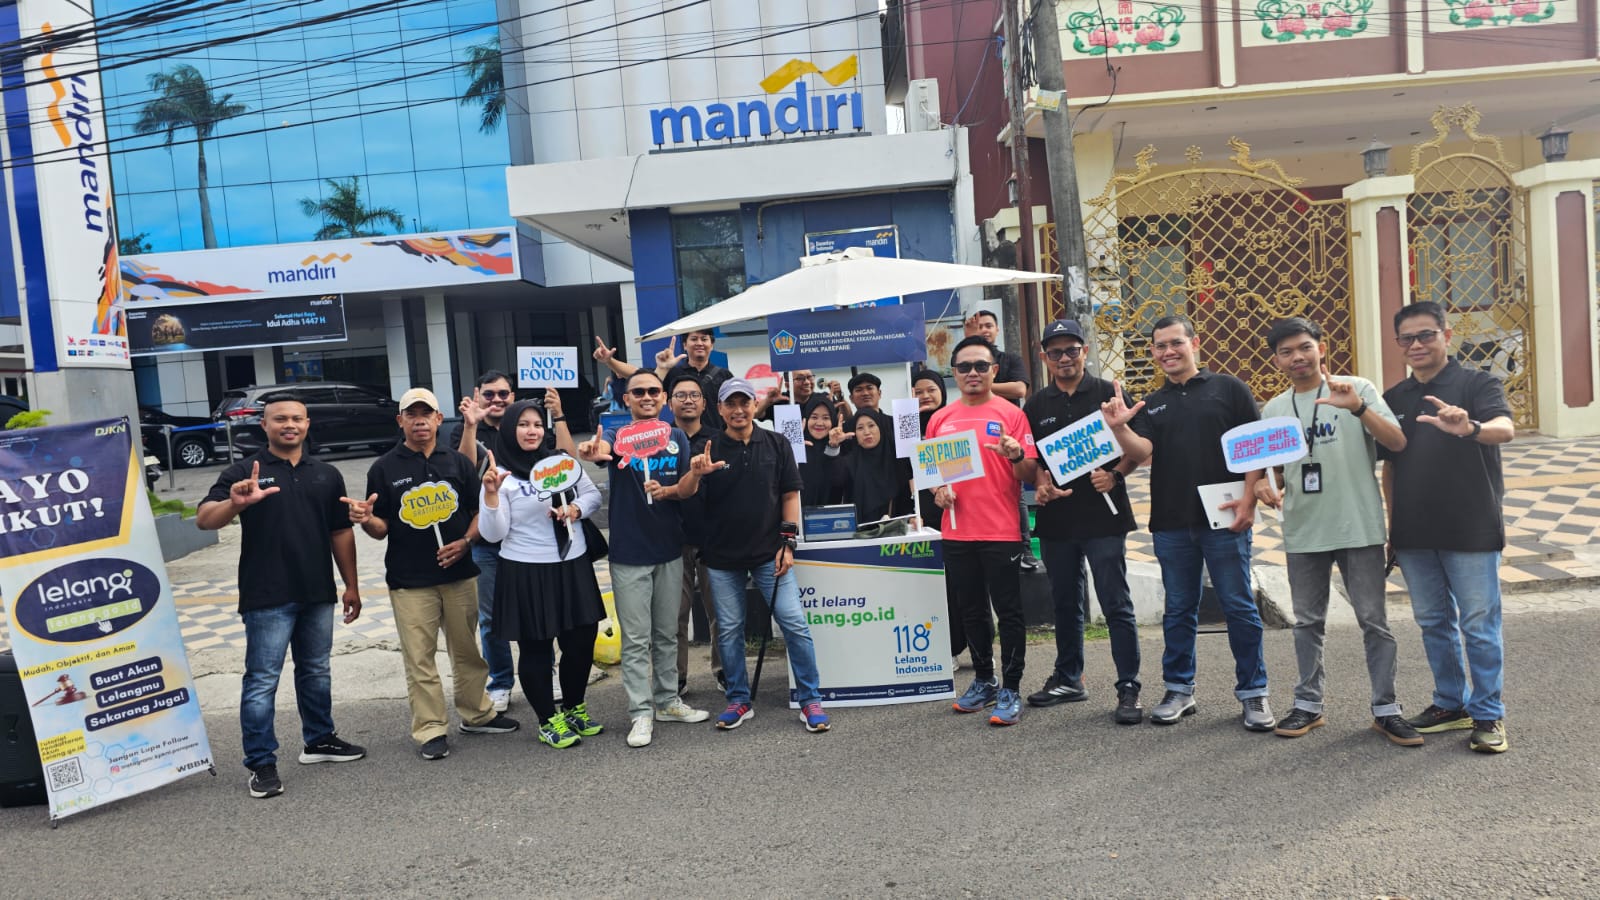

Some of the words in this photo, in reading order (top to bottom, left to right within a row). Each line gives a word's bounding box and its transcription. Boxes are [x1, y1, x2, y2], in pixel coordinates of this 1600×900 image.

[650, 81, 863, 145] mandiri
[66, 75, 103, 233] mandiri
[268, 264, 336, 283] mandiri
[800, 332, 840, 340] KEMENTERIAN
[841, 328, 875, 336] KEUANGAN
[531, 357, 564, 369] NOT
[520, 368, 575, 381] FOUND
[95, 425, 126, 437] DJKN
[622, 427, 666, 444] #INTEGRITY
[1045, 419, 1104, 456] PASUKAN
[1234, 437, 1264, 451] gaya
[1268, 430, 1289, 442] elit
[633, 438, 660, 450] WEEK
[937, 440, 971, 461] PALING
[1067, 436, 1096, 459] ANTI
[1268, 438, 1297, 451] sulit
[1059, 441, 1114, 476] KORUPSI
[0, 469, 89, 504] AYO
[543, 472, 568, 489] Style
[407, 490, 452, 509] TOLAK
[0, 497, 104, 534] IKUT!
[880, 541, 934, 556] KPKNL
[799, 587, 815, 598] yo
[800, 599, 818, 608] ut
[822, 596, 866, 608] lelang
[807, 607, 895, 627] lang.go.id
[893, 624, 930, 653] 118
[23, 664, 54, 677] Mudah,
[56, 654, 93, 667] Objektif,
[96, 650, 111, 658] dan
[113, 643, 136, 653] Aman
[895, 656, 927, 664] Lelang
[896, 663, 943, 674] Indonesia
[95, 672, 124, 686] Buat
[127, 663, 158, 677] Akun
[101, 682, 160, 704] Lelangmu
[90, 705, 149, 727] Sekarang
[153, 691, 185, 710] Juga!
[177, 757, 209, 773] WBBM
